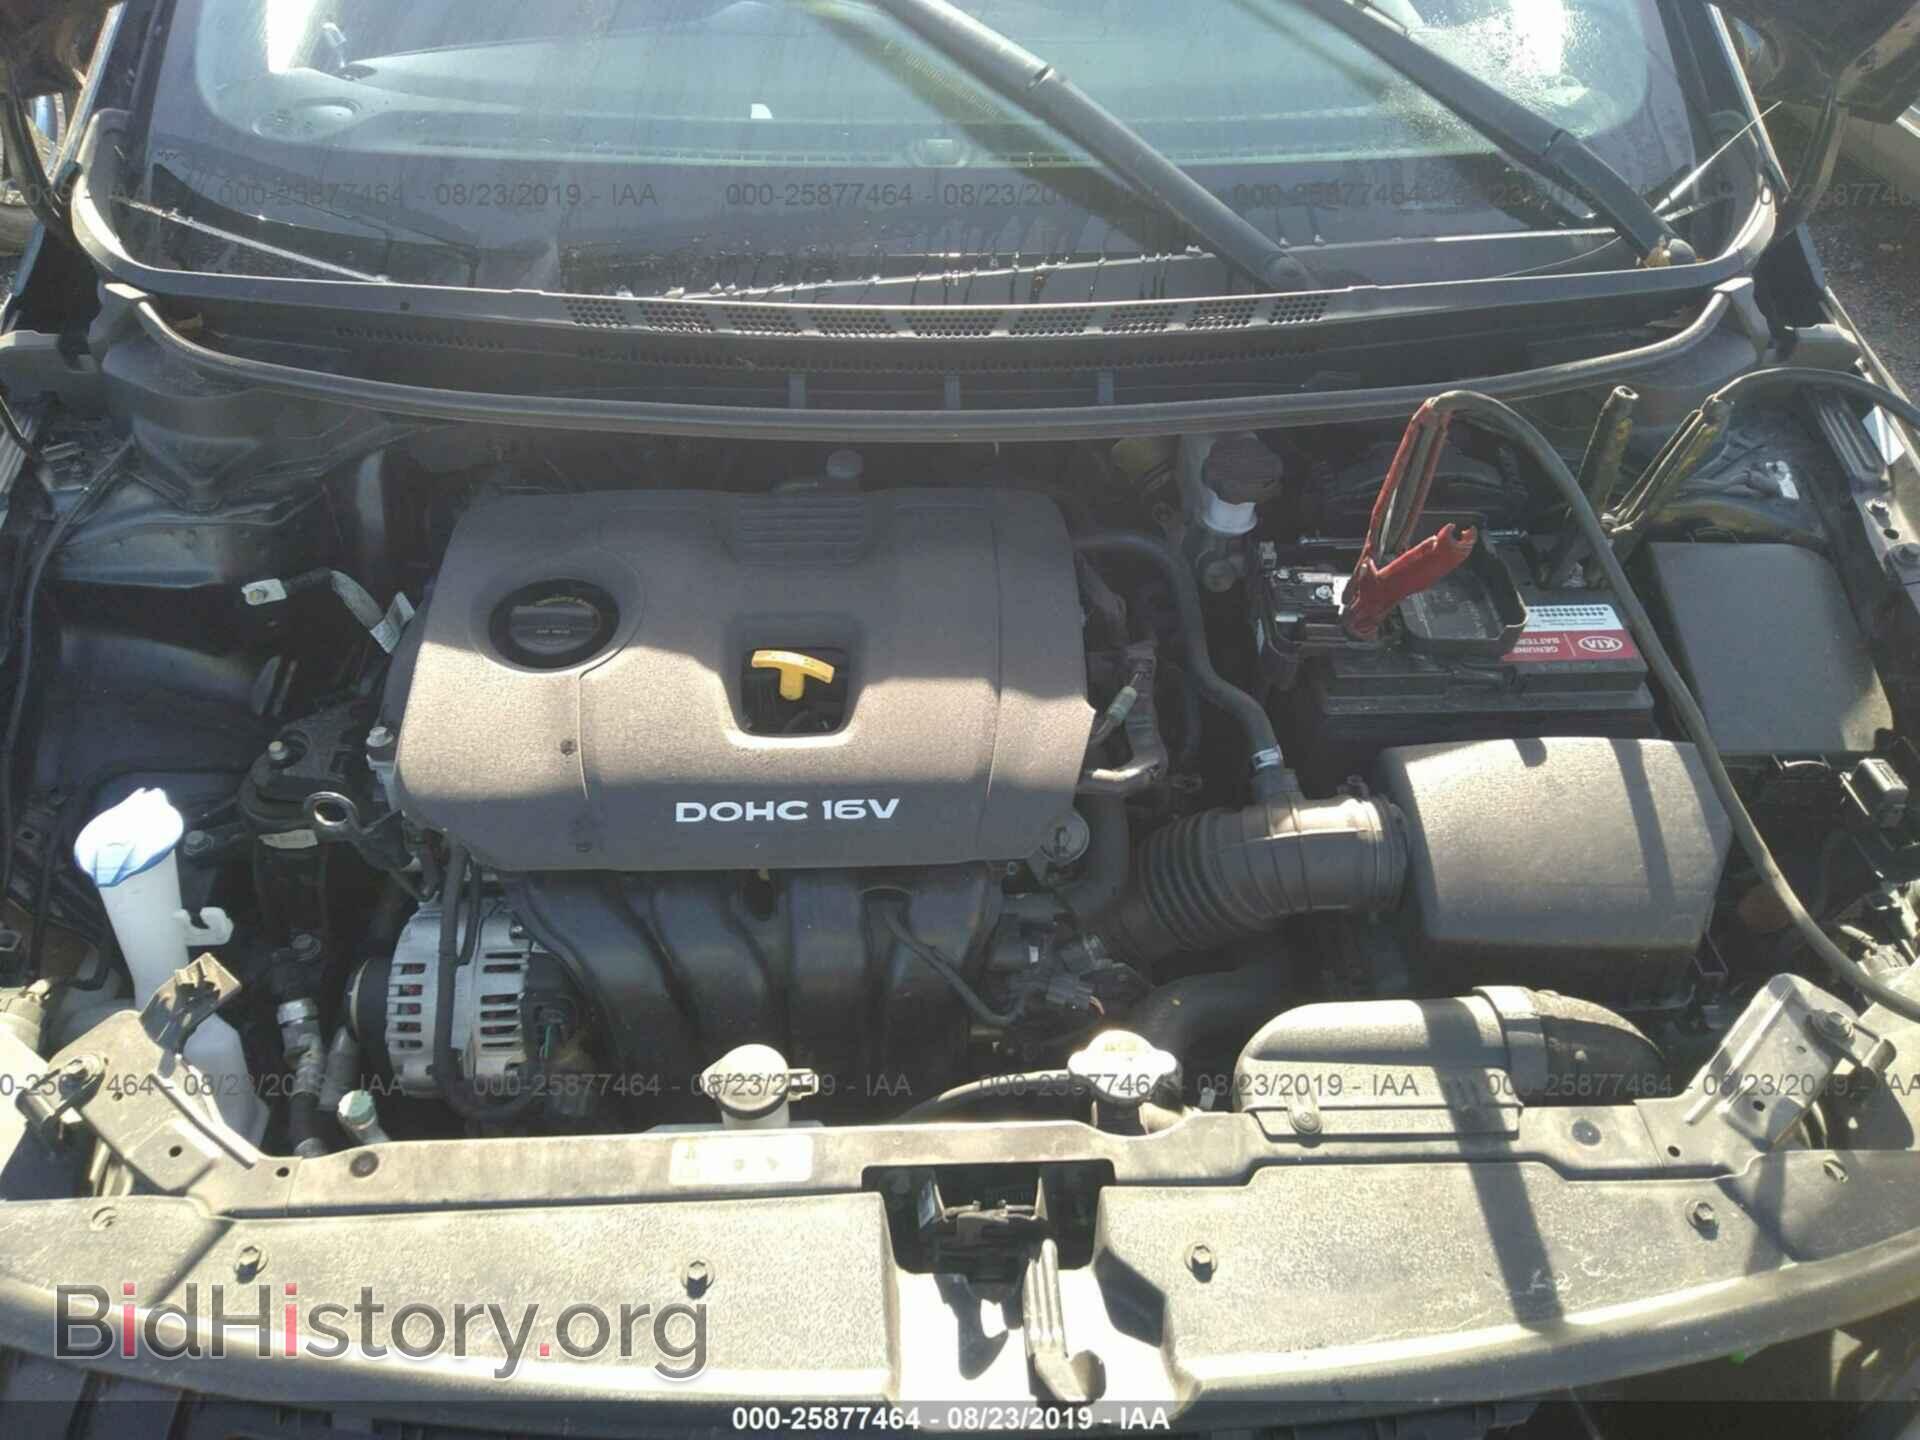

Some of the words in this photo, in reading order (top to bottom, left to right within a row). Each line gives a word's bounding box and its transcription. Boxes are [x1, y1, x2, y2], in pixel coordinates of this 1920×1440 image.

[1515, 636, 1560, 646] BATTER
[675, 800, 808, 823] DOHC
[822, 798, 900, 820] 16V
